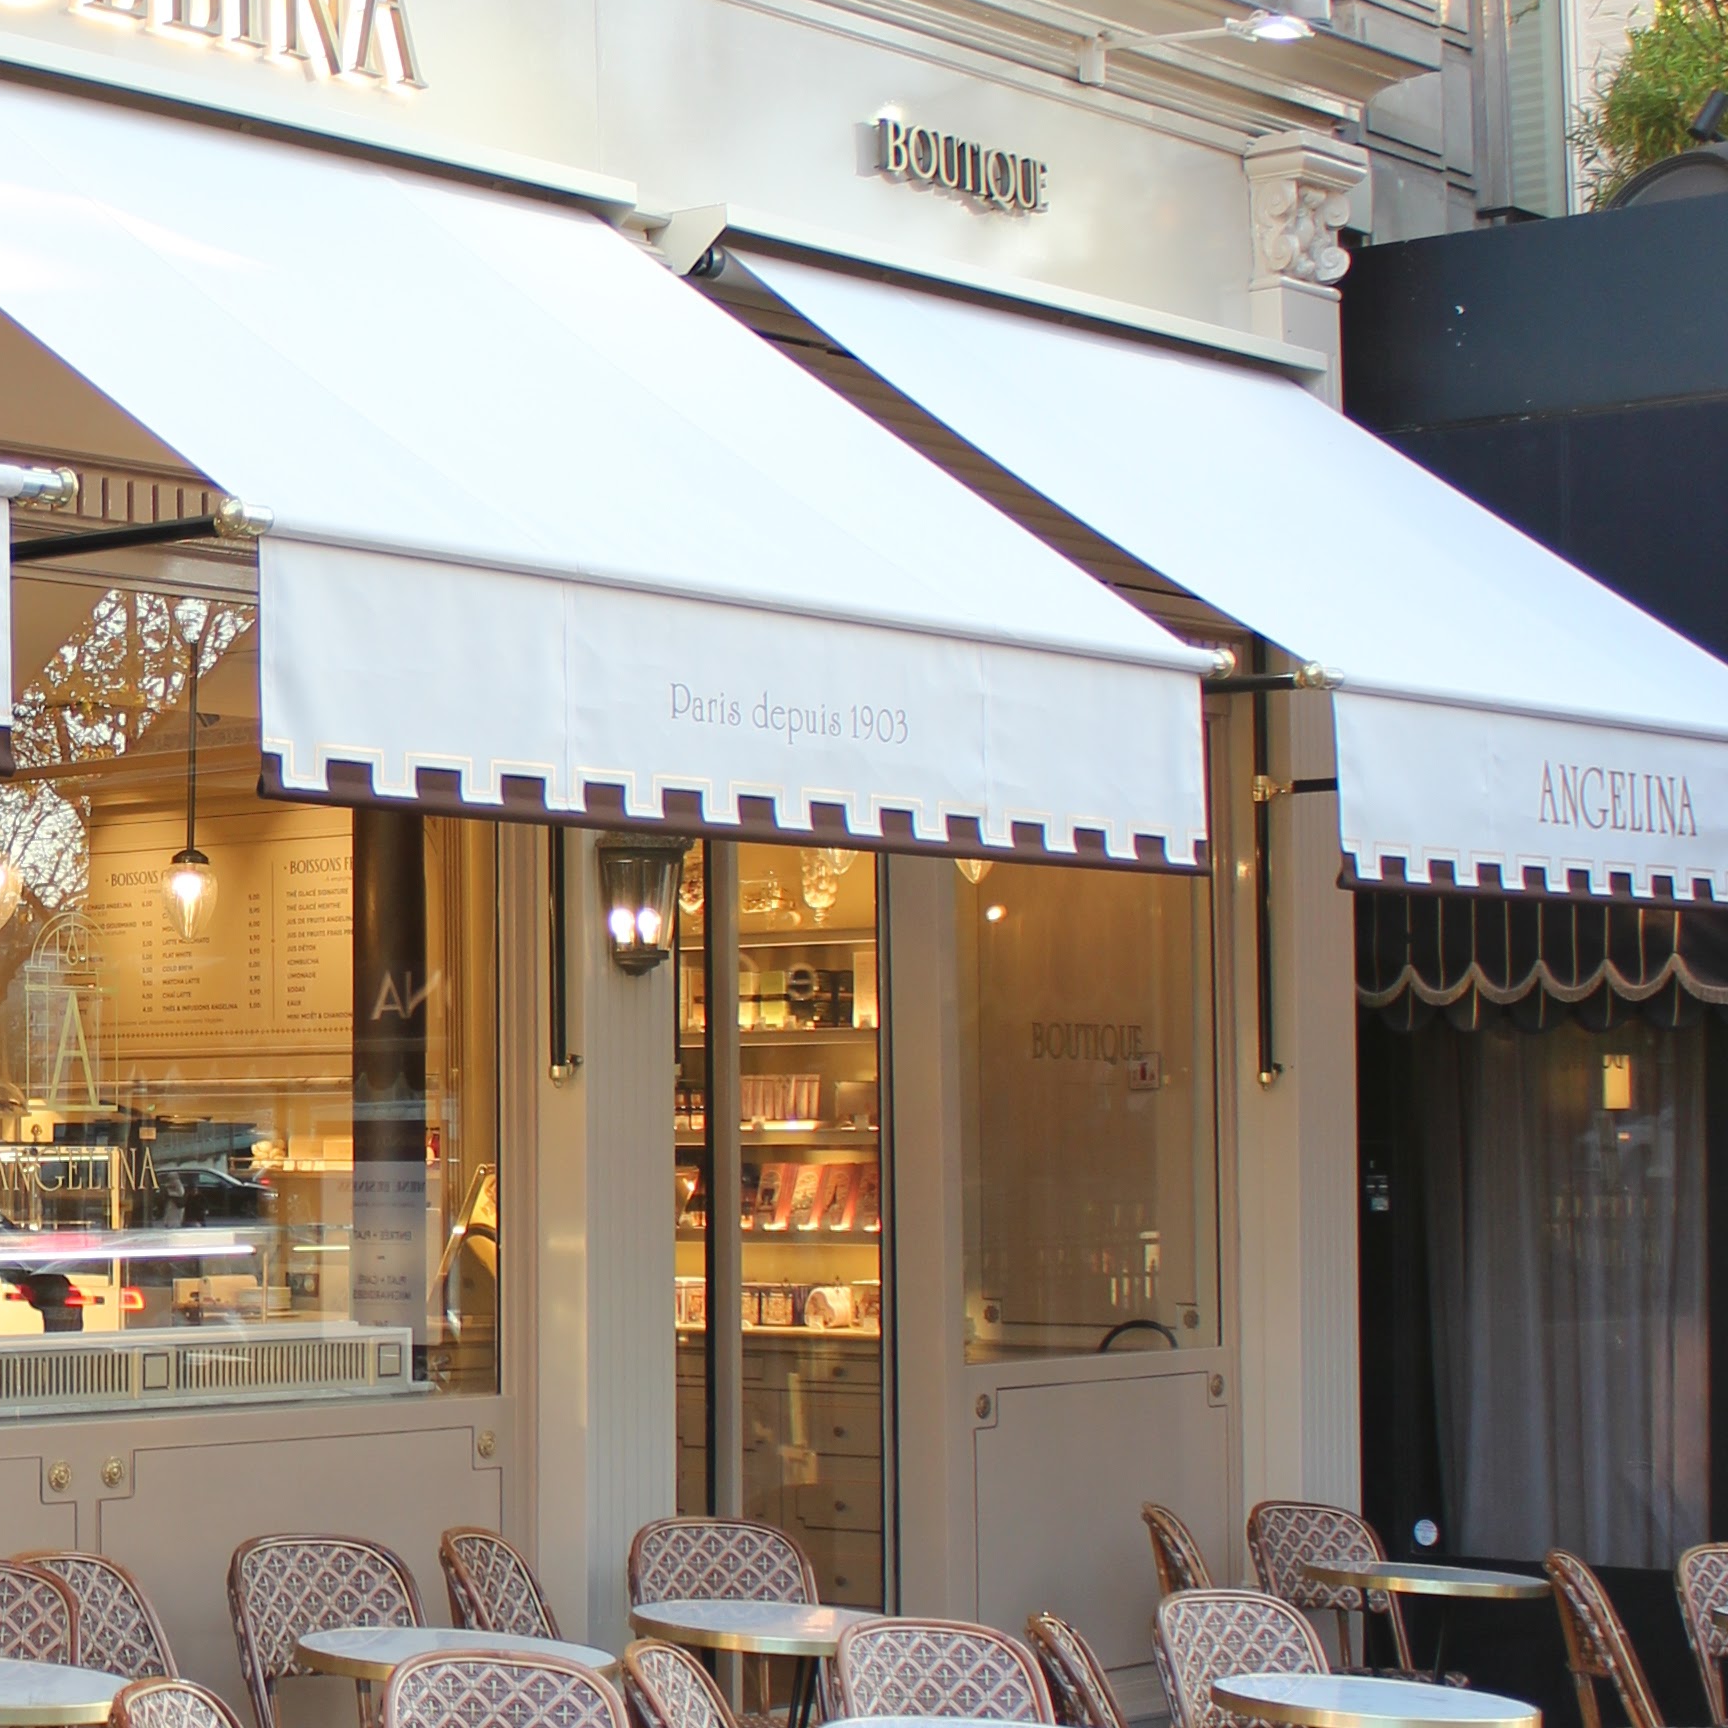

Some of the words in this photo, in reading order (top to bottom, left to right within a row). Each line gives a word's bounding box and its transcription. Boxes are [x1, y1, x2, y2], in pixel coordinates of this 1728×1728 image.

[878, 118, 1050, 214] BOUTIQUE
[670, 682, 742, 727] Paris
[752, 690, 842, 745] depuis
[850, 703, 909, 745] 1903
[1538, 759, 1698, 838] ANGELINA
[111, 871, 159, 887] BOISSONS
[290, 856, 341, 875] BOISSONS
[1031, 1022, 1143, 1065] BOUTIQUE
